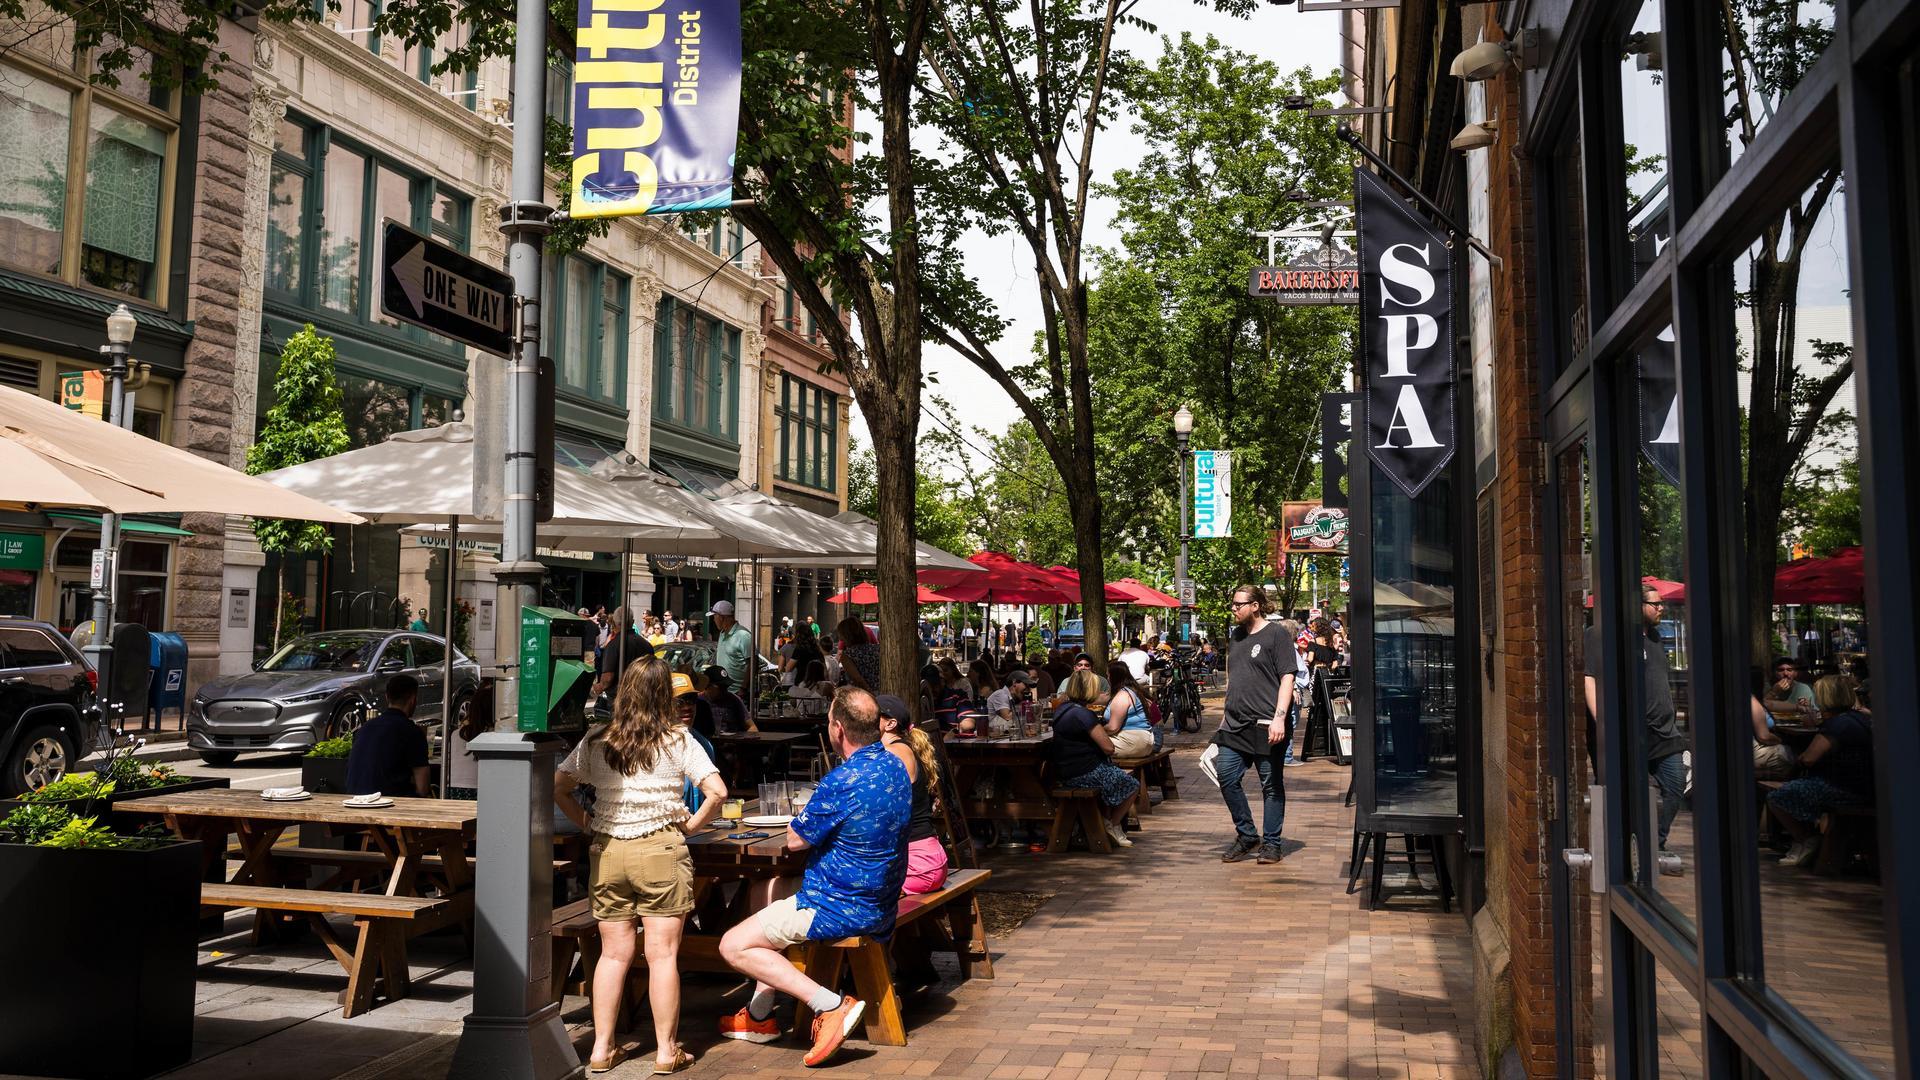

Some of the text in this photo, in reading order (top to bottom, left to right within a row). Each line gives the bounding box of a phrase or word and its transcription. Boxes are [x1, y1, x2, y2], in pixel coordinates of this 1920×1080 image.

[673, 10, 701, 105] District
[571, 0, 666, 218] Cult
[423, 265, 500, 326] ONE WAY
[1374, 242, 1446, 450] SPA
[1194, 450, 1215, 538] Cultural
[1293, 526, 1317, 538] AUGUST
[420, 535, 476, 549] COURARD
